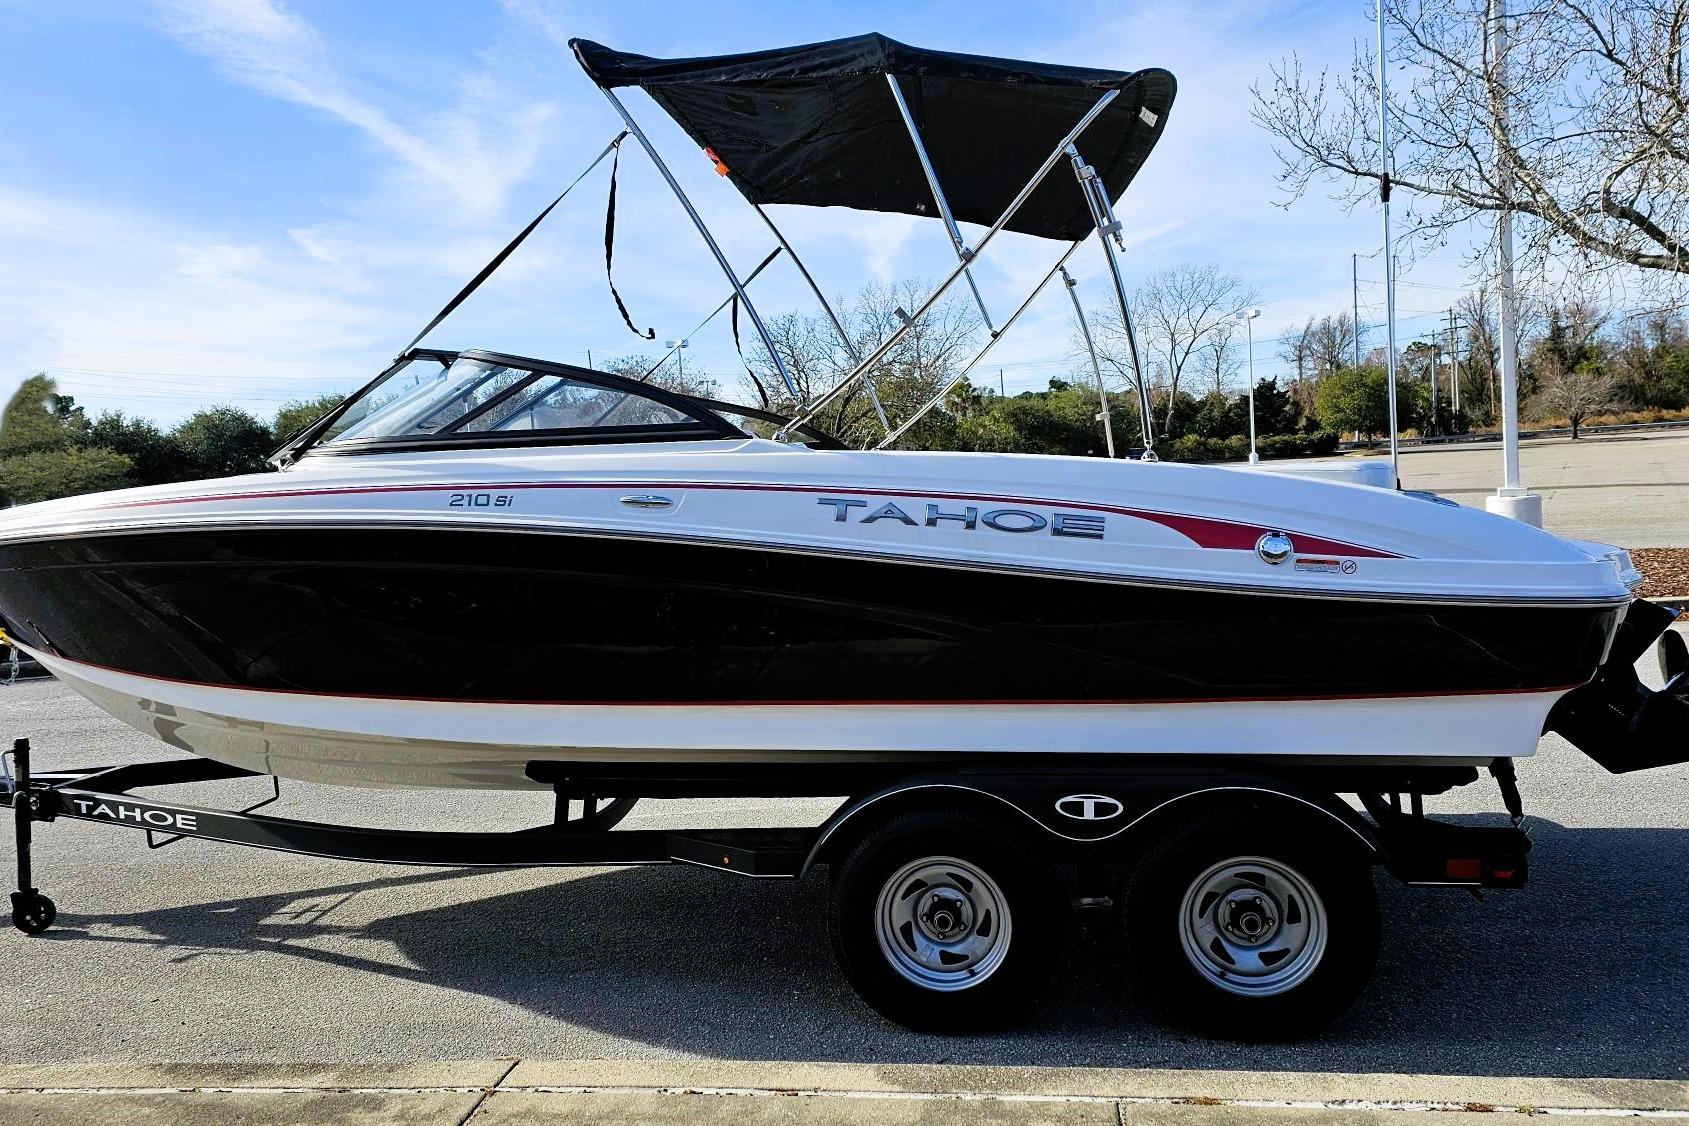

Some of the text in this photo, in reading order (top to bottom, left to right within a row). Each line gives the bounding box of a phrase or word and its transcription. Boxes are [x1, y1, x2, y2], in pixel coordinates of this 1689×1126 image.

[450, 494, 490, 507] 210
[817, 497, 1106, 540] TAHOE
[73, 799, 197, 831] TAHOE
